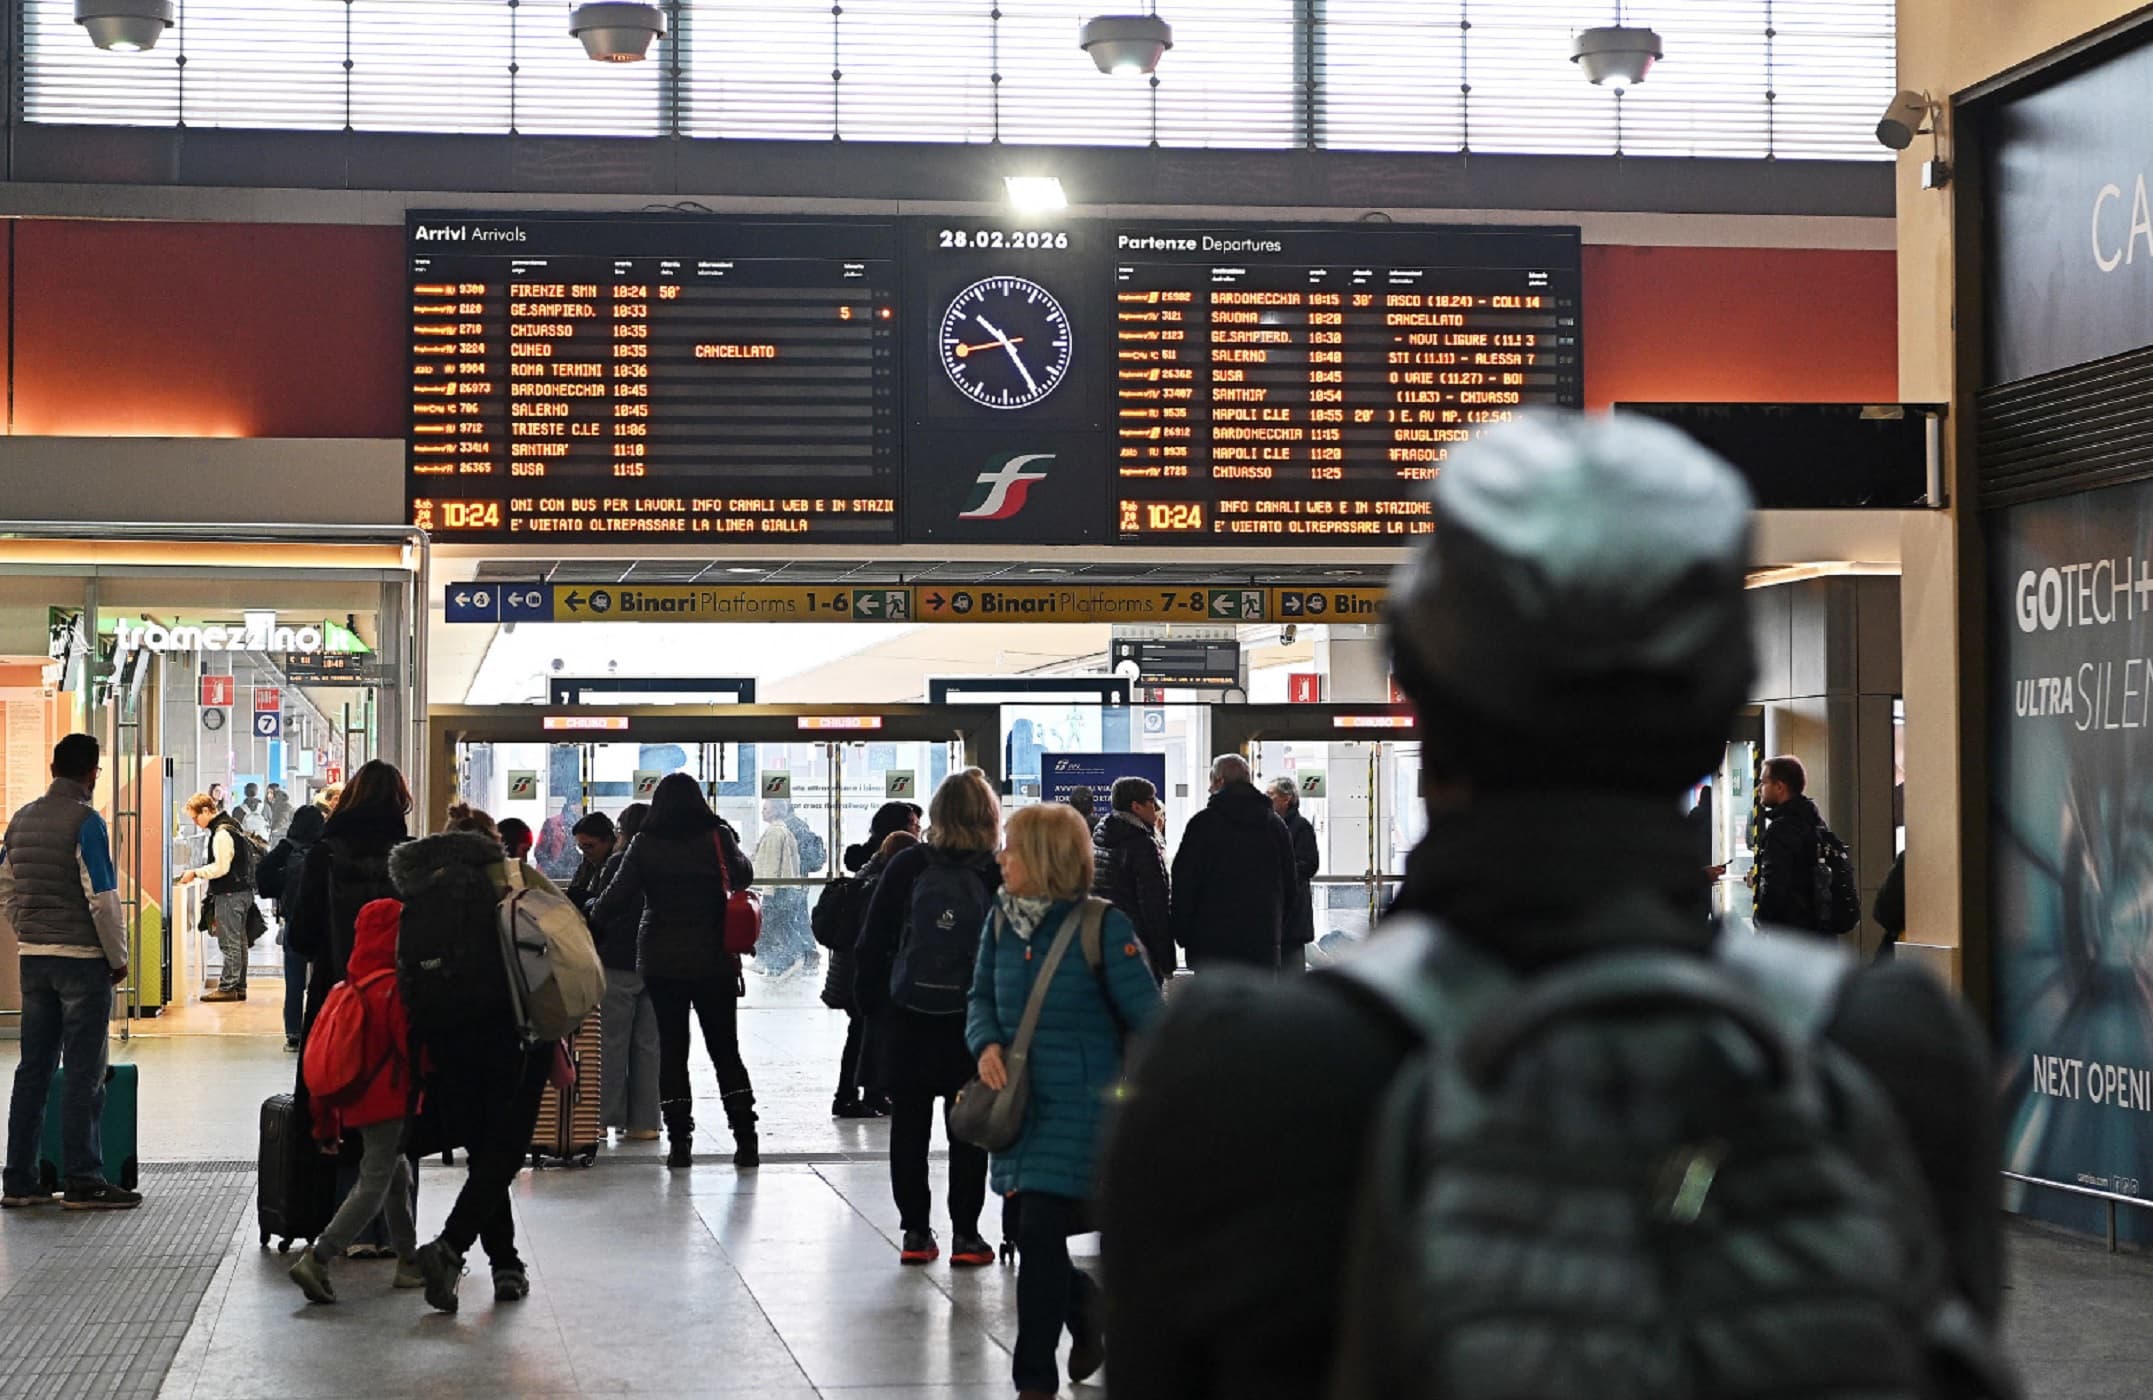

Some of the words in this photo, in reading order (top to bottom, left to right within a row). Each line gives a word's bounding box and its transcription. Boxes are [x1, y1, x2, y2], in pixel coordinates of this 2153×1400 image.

[415, 225, 466, 241] Arrivi
[471, 226, 527, 242] Arrivals
[939, 230, 1068, 249] 28.02.2026
[1118, 235, 1197, 250] Partenze
[1202, 236, 1282, 253] Departures
[510, 284, 565, 298] FIRENZE
[613, 285, 647, 298] 10:24
[1210, 292, 1301, 305] BARDONECCHIA
[1308, 293, 1340, 306] 10:15
[510, 303, 596, 318] GE.SAMPIERD.
[613, 304, 647, 318] 10:33
[839, 306, 851, 320] 5
[1211, 310, 1259, 324] SAVONA
[1308, 312, 1342, 325] 10:20
[1386, 313, 1463, 327] CANCELLATO
[510, 323, 573, 337] CHIVASSO
[613, 324, 647, 338] 10:35
[1210, 330, 1293, 343] GE.SAMPIERD.
[1309, 331, 1342, 344] 10:30
[1408, 333, 1438, 346] NOVI
[1444, 333, 1488, 346] LIGURE
[1525, 334, 1535, 347] 3
[510, 342, 552, 357] CUNEO
[613, 344, 647, 358] 10:35
[695, 344, 775, 358] CANCELLATO
[1211, 349, 1268, 363] SALERNO
[1309, 351, 1342, 364] 10:40
[1526, 353, 1535, 365] 7
[511, 363, 544, 376] ROMA
[551, 363, 602, 378] TERMINI
[613, 363, 648, 378] 10:36
[1212, 369, 1244, 382] SUSA
[1309, 370, 1342, 383] 10:45
[1404, 371, 1434, 385] VAIE
[511, 383, 605, 397] BARDONECCHIA
[614, 383, 648, 397] 10:45
[1212, 387, 1267, 402] SANTHIA'
[1309, 389, 1342, 402] 10:54
[1460, 391, 1519, 404] CHIVASSO
[511, 402, 569, 417] SALERNO
[614, 404, 648, 417] 10:45
[1212, 408, 1257, 421] NAPOLI
[1262, 408, 1290, 421] C.LE
[1310, 409, 1343, 422] 10:55
[1418, 409, 1435, 423] AV
[511, 422, 565, 436] TRIESTE
[571, 422, 600, 436] C.LE
[614, 423, 647, 436] 11:06
[1212, 426, 1303, 441] BARDONECCHIA
[1311, 428, 1340, 441] 11:15
[1394, 429, 1469, 441] GRUGLIASCO
[511, 443, 569, 456] SANTHIA'
[614, 443, 645, 457] 11:10
[1212, 447, 1257, 460] NAPOLI
[1263, 447, 1290, 460] C.LE
[1311, 447, 1342, 460] 11:20
[511, 462, 545, 476] SUSA
[613, 462, 645, 477] 11:15
[1212, 465, 1272, 479] CHIVASSO
[1311, 467, 1342, 480] 11:25
[510, 498, 533, 512] ONI
[539, 498, 565, 512] CON
[571, 498, 597, 512] BUS
[603, 498, 629, 512] PER
[692, 498, 722, 512] INFO
[729, 499, 775, 512] CANALI
[782, 499, 809, 512] WEB
[815, 499, 825, 512] E
[831, 499, 846, 512] IN
[1220, 500, 1249, 513] INFO
[1255, 500, 1301, 514] CANALI
[1306, 500, 1333, 514] WEB
[1339, 500, 1348, 514] E
[1354, 501, 1368, 514] IN
[1375, 501, 1431, 515] STAZIONE
[441, 502, 500, 527] 10:24
[1146, 504, 1202, 529] 10:24
[529, 518, 583, 531] VIETATO
[589, 518, 686, 531] OLTREPASSARE
[692, 518, 710, 532] LA
[716, 518, 754, 532] LINEA
[761, 518, 808, 532] GIALLA
[1231, 520, 1283, 533] VIETATO
[1288, 520, 1381, 534] OLTREPASSARE
[1387, 521, 1404, 534] LA
[620, 592, 695, 613] Binari
[701, 592, 796, 613] Platforms
[807, 592, 847, 612] 1-6
[981, 592, 1056, 613] Binari
[1060, 592, 1153, 613] Platforms
[1160, 592, 1204, 613] 7-8
[262, 718, 272, 730] 7
[2033, 1054, 2083, 1099] NEXT
